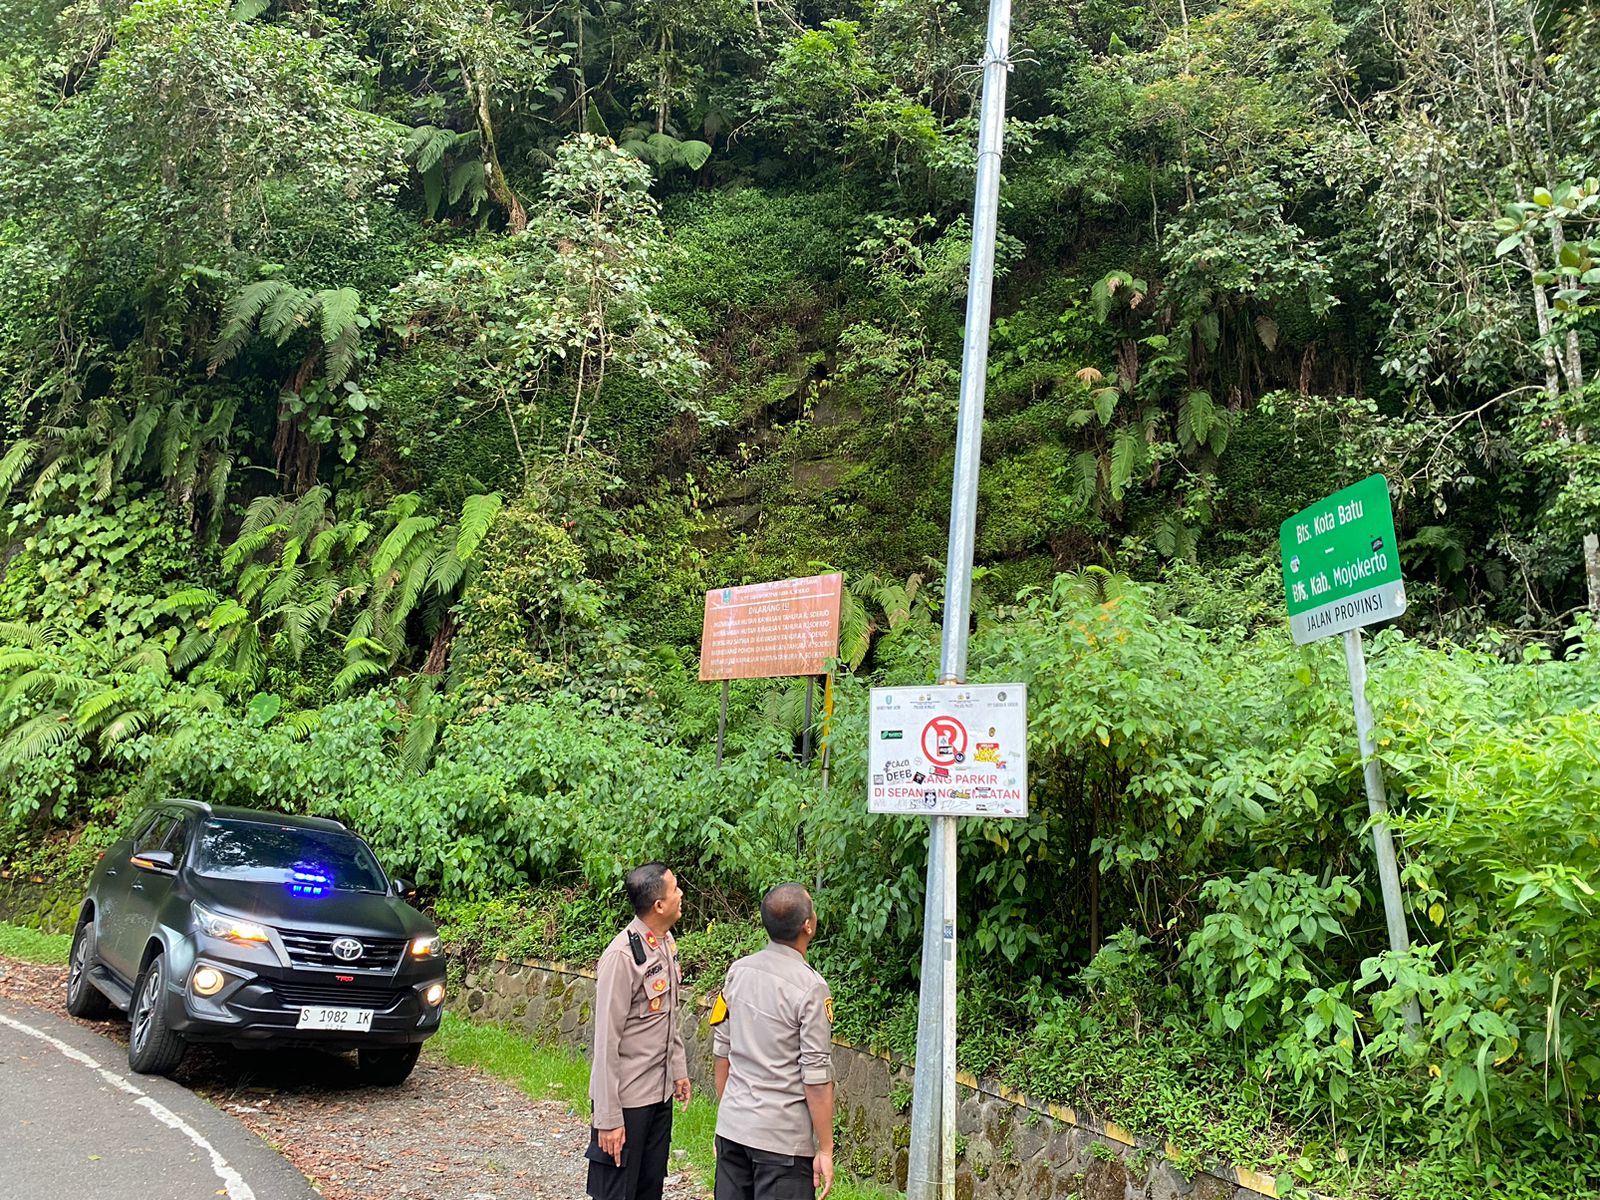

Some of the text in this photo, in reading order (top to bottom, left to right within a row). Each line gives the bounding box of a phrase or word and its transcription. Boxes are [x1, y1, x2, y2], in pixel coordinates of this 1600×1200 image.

[1296, 499, 1364, 544] Bts. Kota Batu
[1310, 571, 1331, 596] Kab.
[1333, 551, 1388, 588] Mojokerto
[1307, 593, 1383, 631] JALAN PROVINSI
[874, 787, 885, 798] DI
[955, 774, 998, 785] PARKIR
[302, 1009, 371, 1024] S 1982 IK
